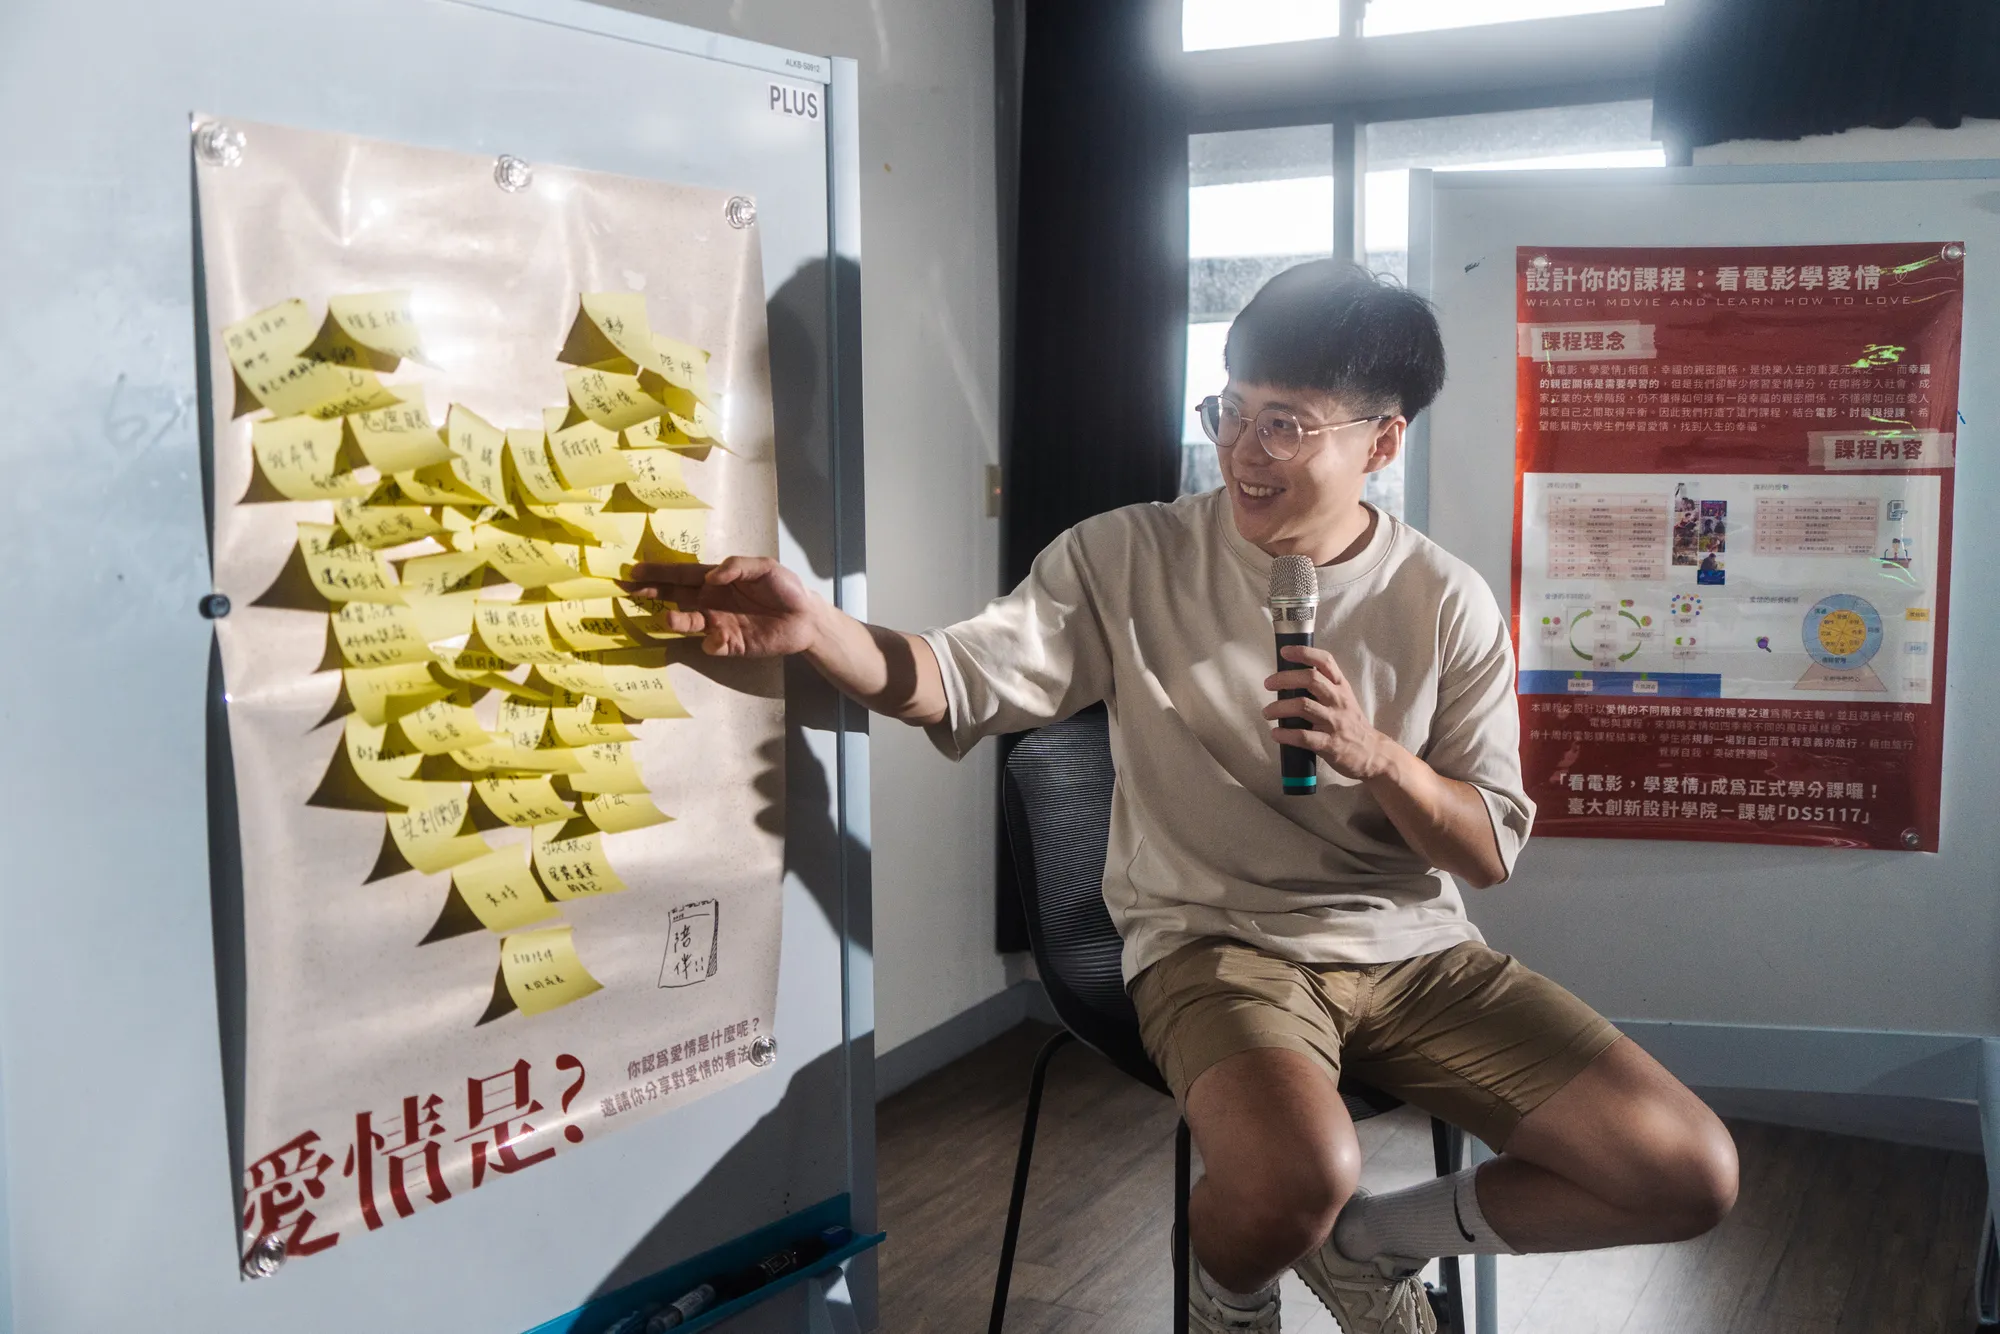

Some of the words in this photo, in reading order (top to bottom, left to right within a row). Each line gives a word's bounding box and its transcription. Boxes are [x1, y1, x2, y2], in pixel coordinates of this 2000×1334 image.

[770, 85, 818, 119] PLUS
[1526, 265, 1881, 293] 設計你的課程：看電影學愛情
[1526, 298, 1596, 307] WHATCH
[1606, 298, 1661, 307] MOVIE
[1671, 298, 1706, 306] AND
[1716, 297, 1774, 306] LEARN
[1785, 297, 1823, 306] HOW
[1834, 297, 1854, 305] TO
[1865, 296, 1911, 305] LOVE
[1541, 331, 1625, 352] 課程理念
[1835, 439, 1923, 460] 課程內容
[600, 1044, 752, 1118] 邀請你分享對愛情的看法
